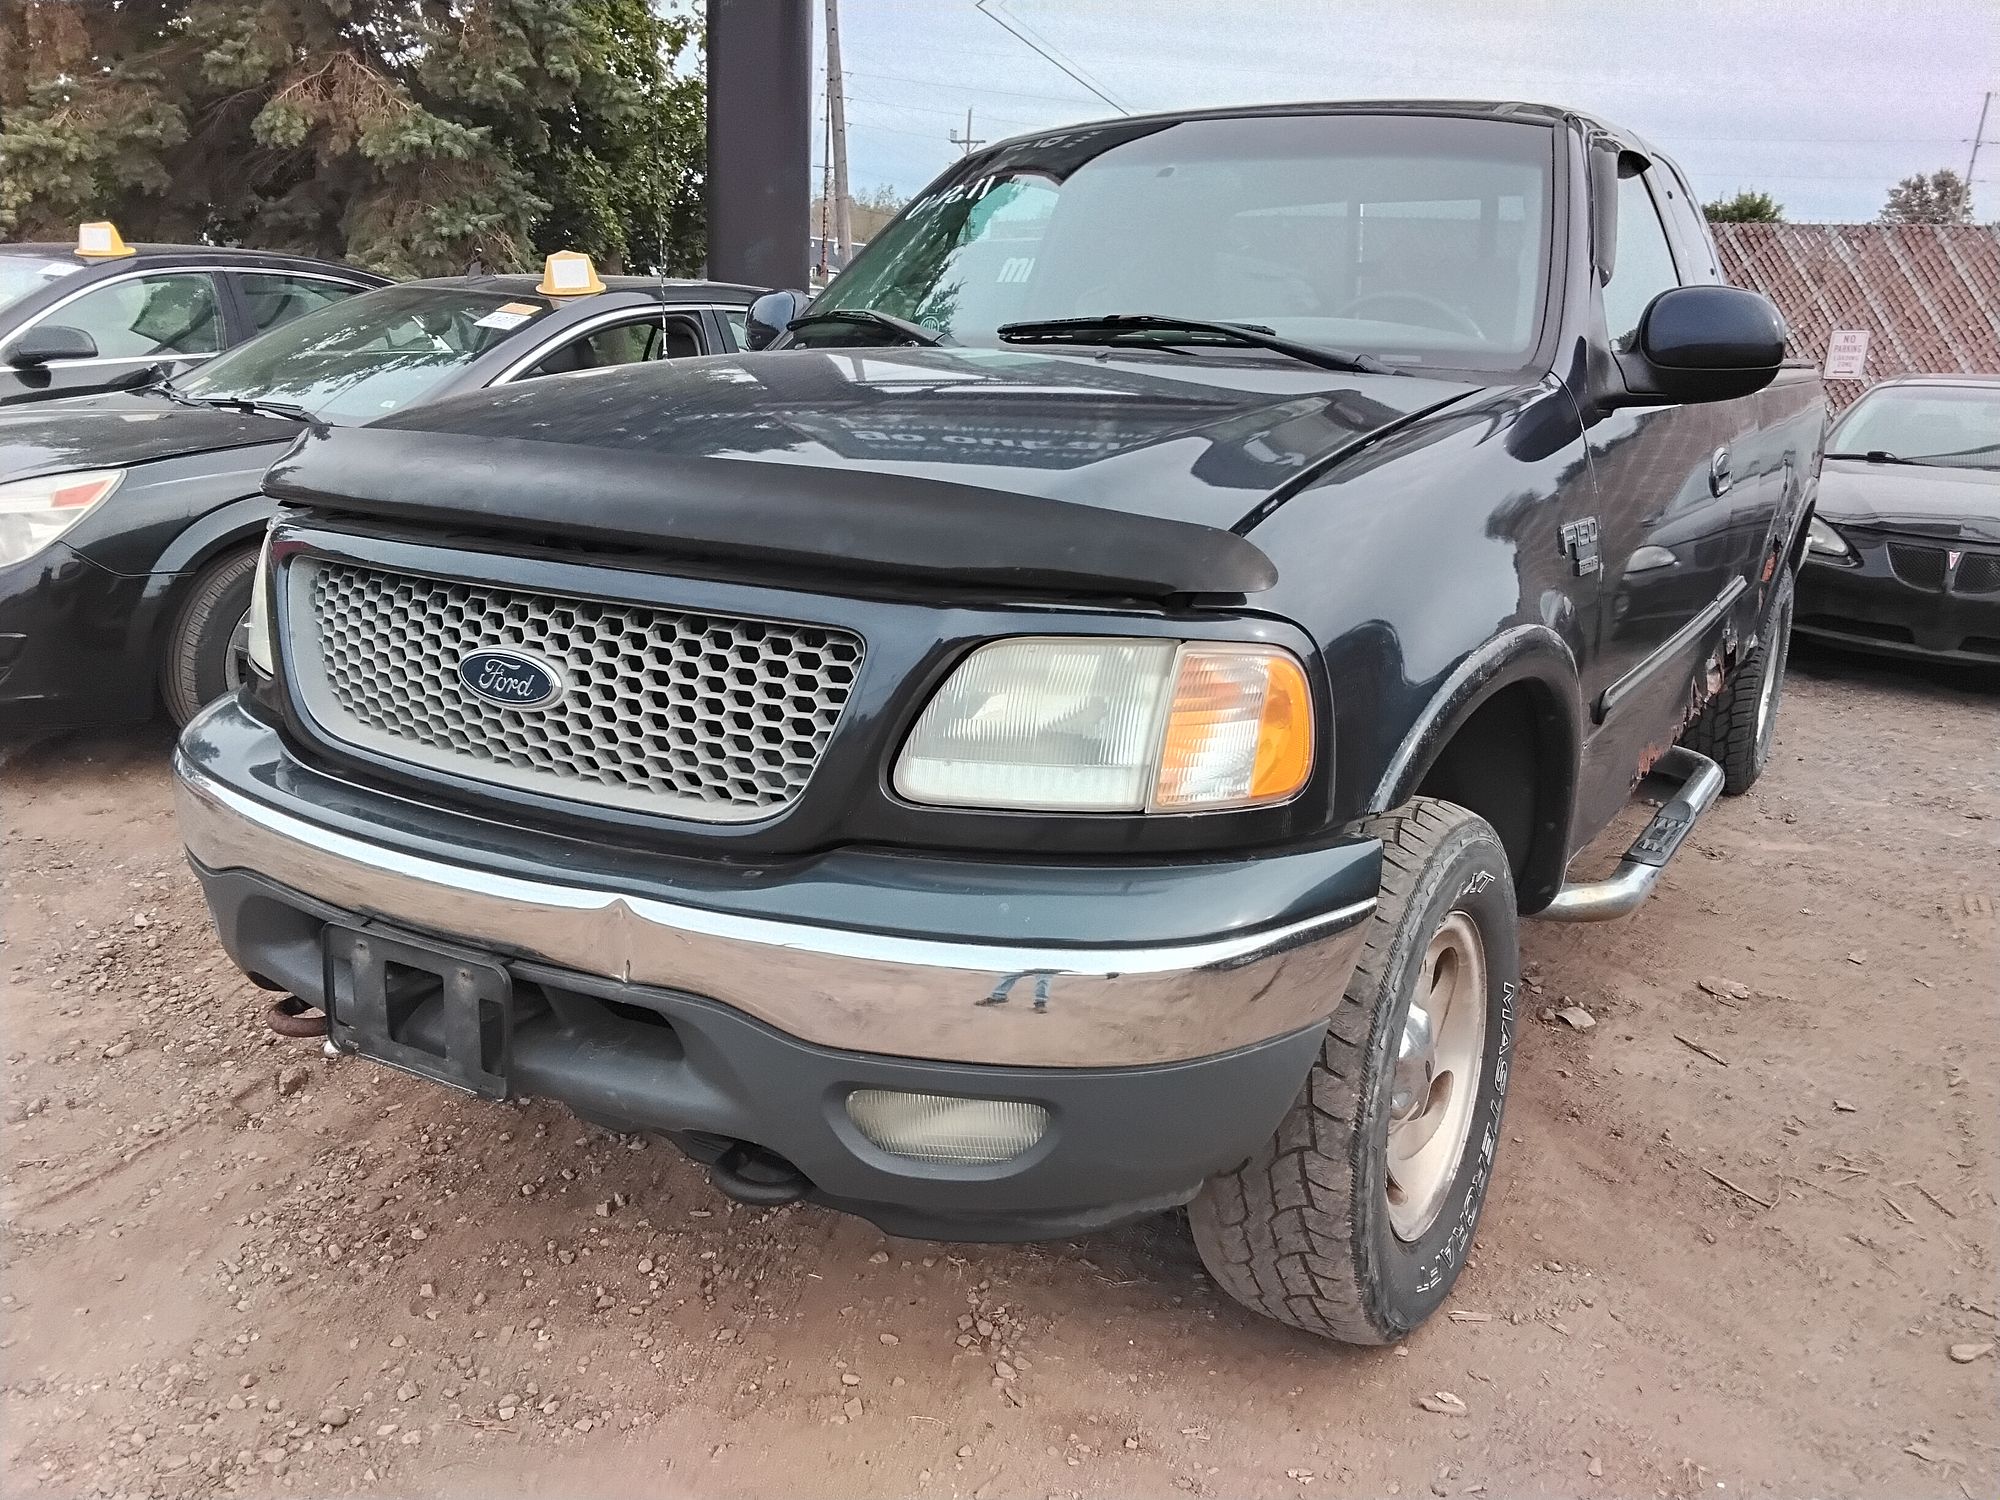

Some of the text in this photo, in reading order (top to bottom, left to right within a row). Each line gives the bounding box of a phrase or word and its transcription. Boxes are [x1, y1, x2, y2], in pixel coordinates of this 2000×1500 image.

[1833, 344, 1863, 353] PARKING
[1843, 335, 1857, 344] NO
[479, 659, 535, 697] Ford
[1416, 981, 1515, 1293] MASTERCRAFT
